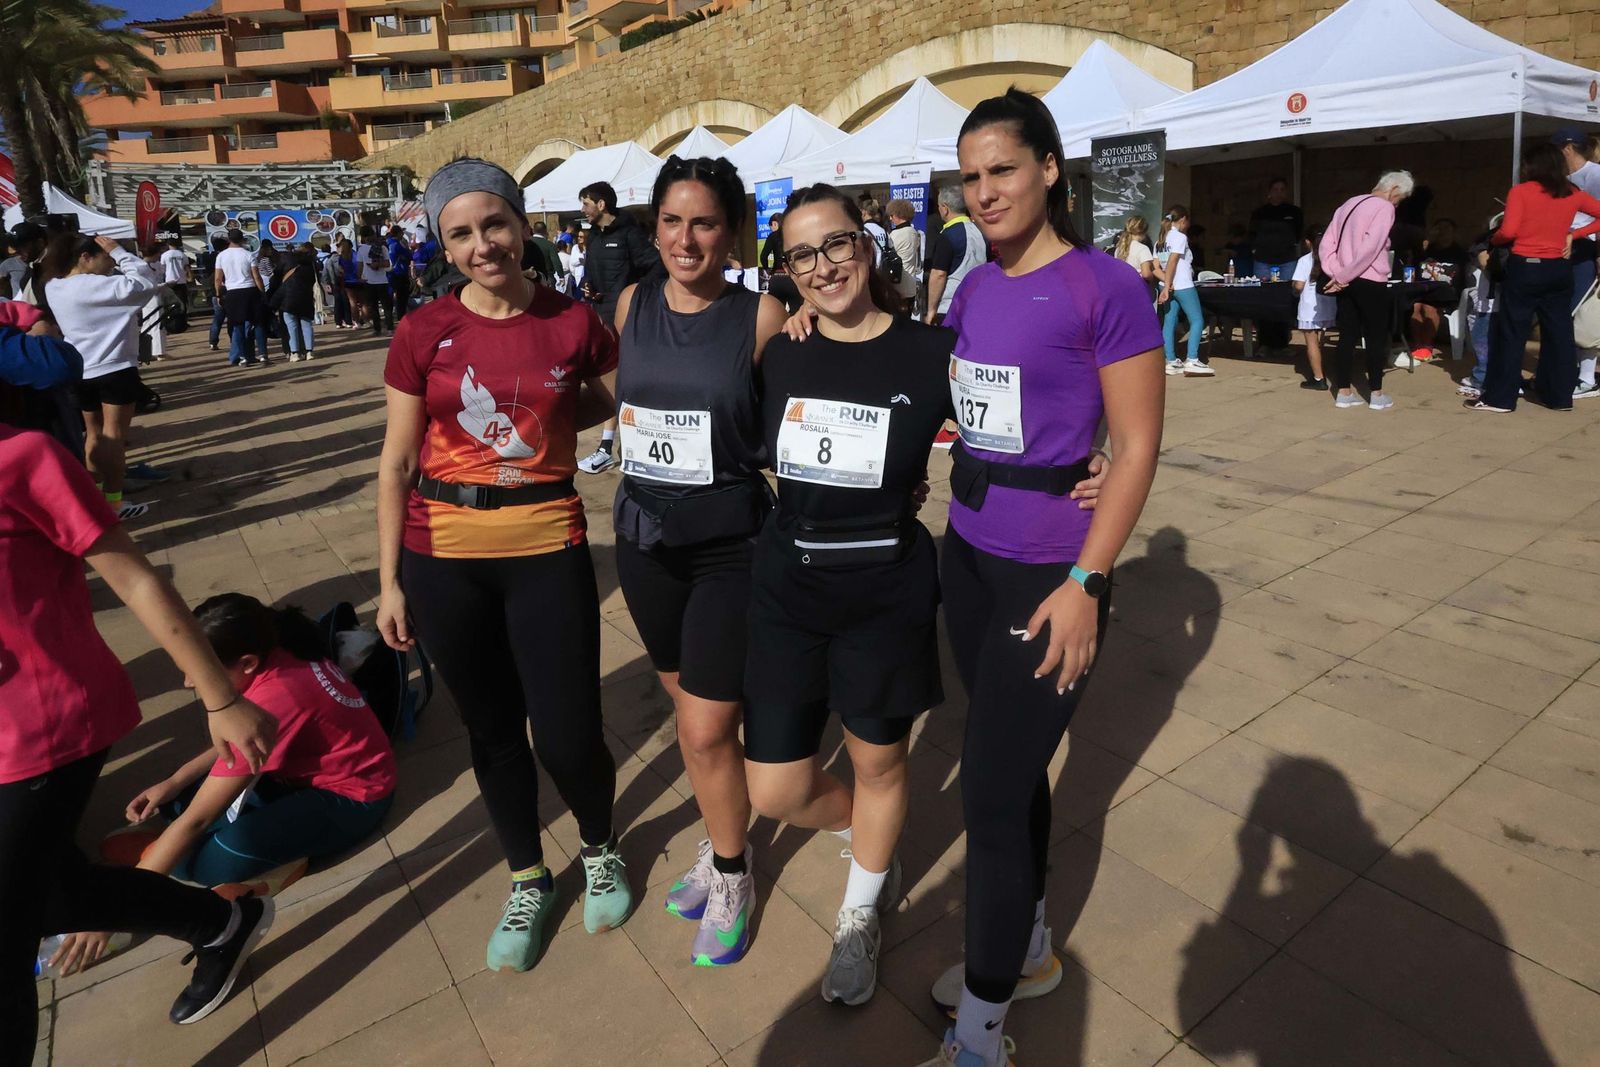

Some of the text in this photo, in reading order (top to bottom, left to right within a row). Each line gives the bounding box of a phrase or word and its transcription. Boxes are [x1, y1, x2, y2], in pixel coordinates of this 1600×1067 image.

[1101, 143, 1153, 157] SOTOGRANDE
[1097, 157, 1111, 166] SPA
[1117, 152, 1158, 164] WELLNESS
[903, 187, 924, 199] EASTER
[975, 367, 1010, 385] RUN
[649, 412, 662, 421] The
[664, 414, 700, 427] RUN
[821, 403, 837, 414] The
[840, 406, 879, 424] RUN
[960, 397, 989, 430] 137
[637, 428, 655, 438] MARIA
[800, 424, 829, 434] ROSALIA
[648, 440, 674, 465] 40
[817, 437, 832, 465] 8
[498, 469, 522, 479] SAN
